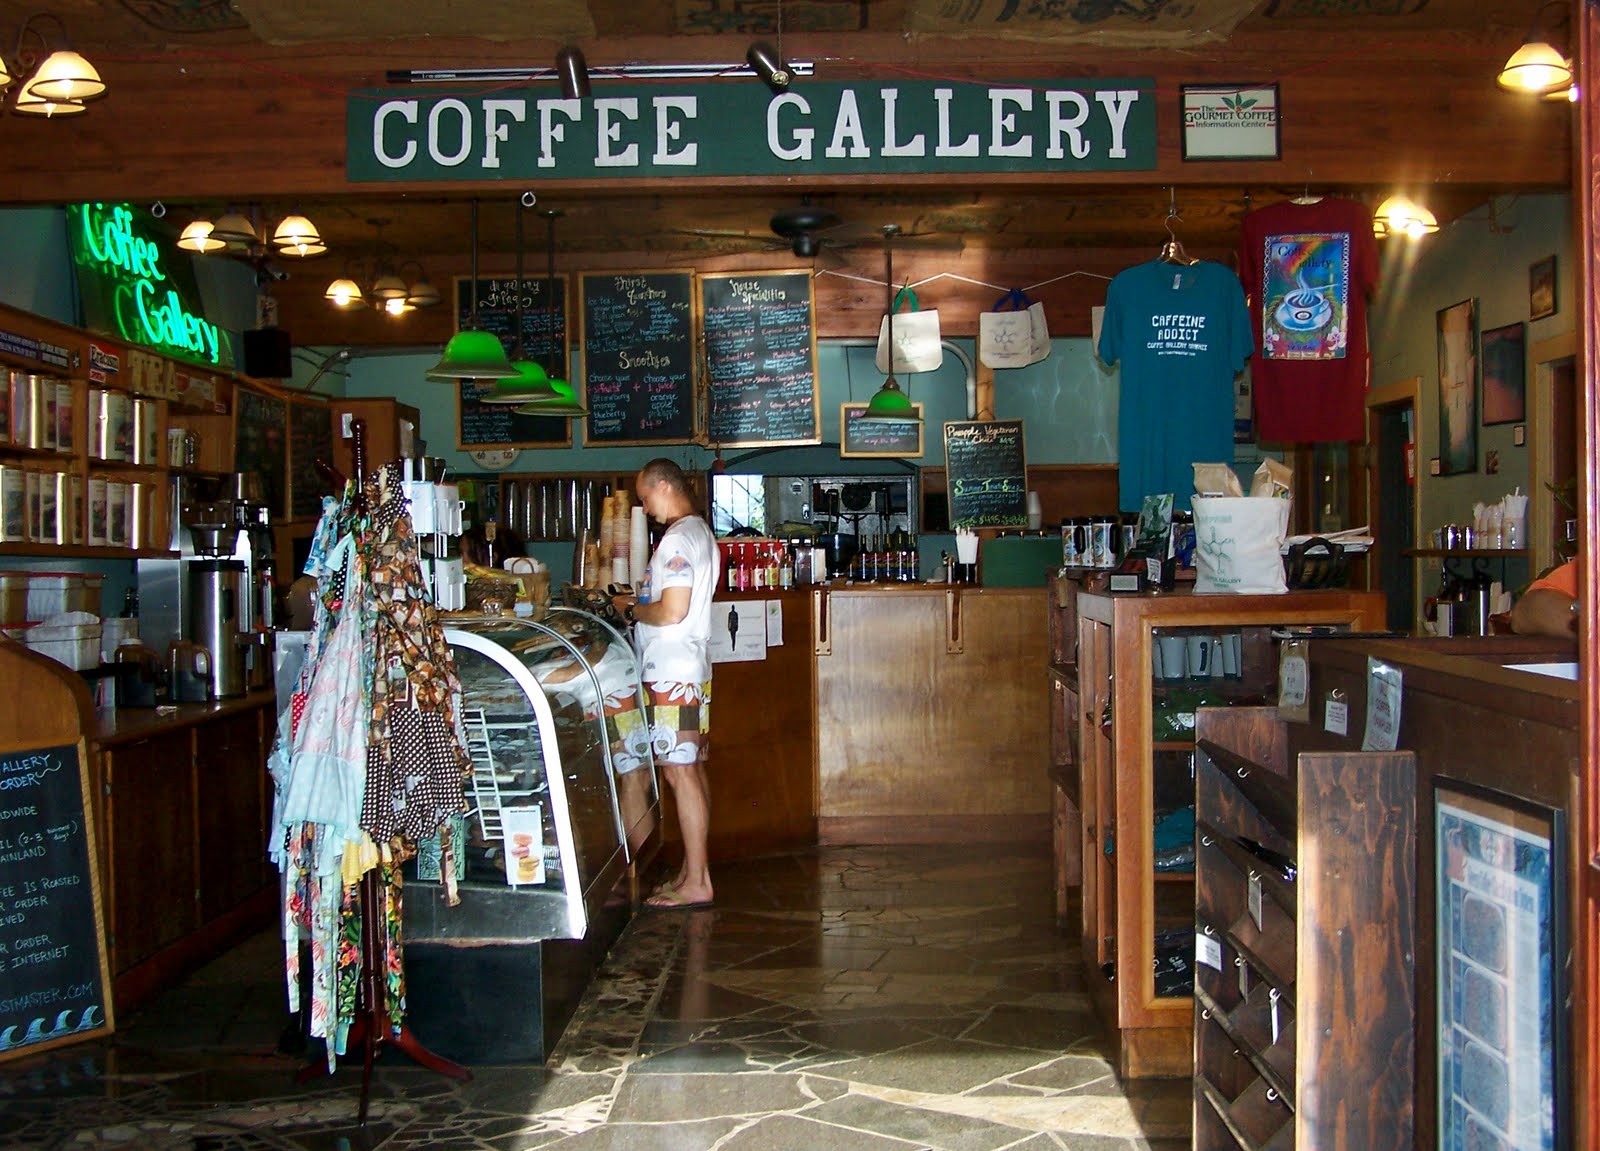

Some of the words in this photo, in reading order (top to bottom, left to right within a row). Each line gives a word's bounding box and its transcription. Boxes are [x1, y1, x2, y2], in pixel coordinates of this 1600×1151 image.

[1185, 111, 1235, 123] GOURMET
[1237, 111, 1276, 122] COFFEE
[373, 96, 698, 169] COFFEE
[766, 88, 1140, 161] GALLERY
[82, 203, 166, 281] Coffee
[135, 278, 219, 364] Gallery
[1151, 314, 1206, 329] CAFFEINE
[1157, 328, 1199, 341] ADDICT
[0, 754, 50, 774] ALLERY
[0, 772, 40, 790] ORDER
[15, 895, 49, 909] ORDER
[15, 934, 51, 950] ORDER
[12, 945, 70, 969] INTERNET
